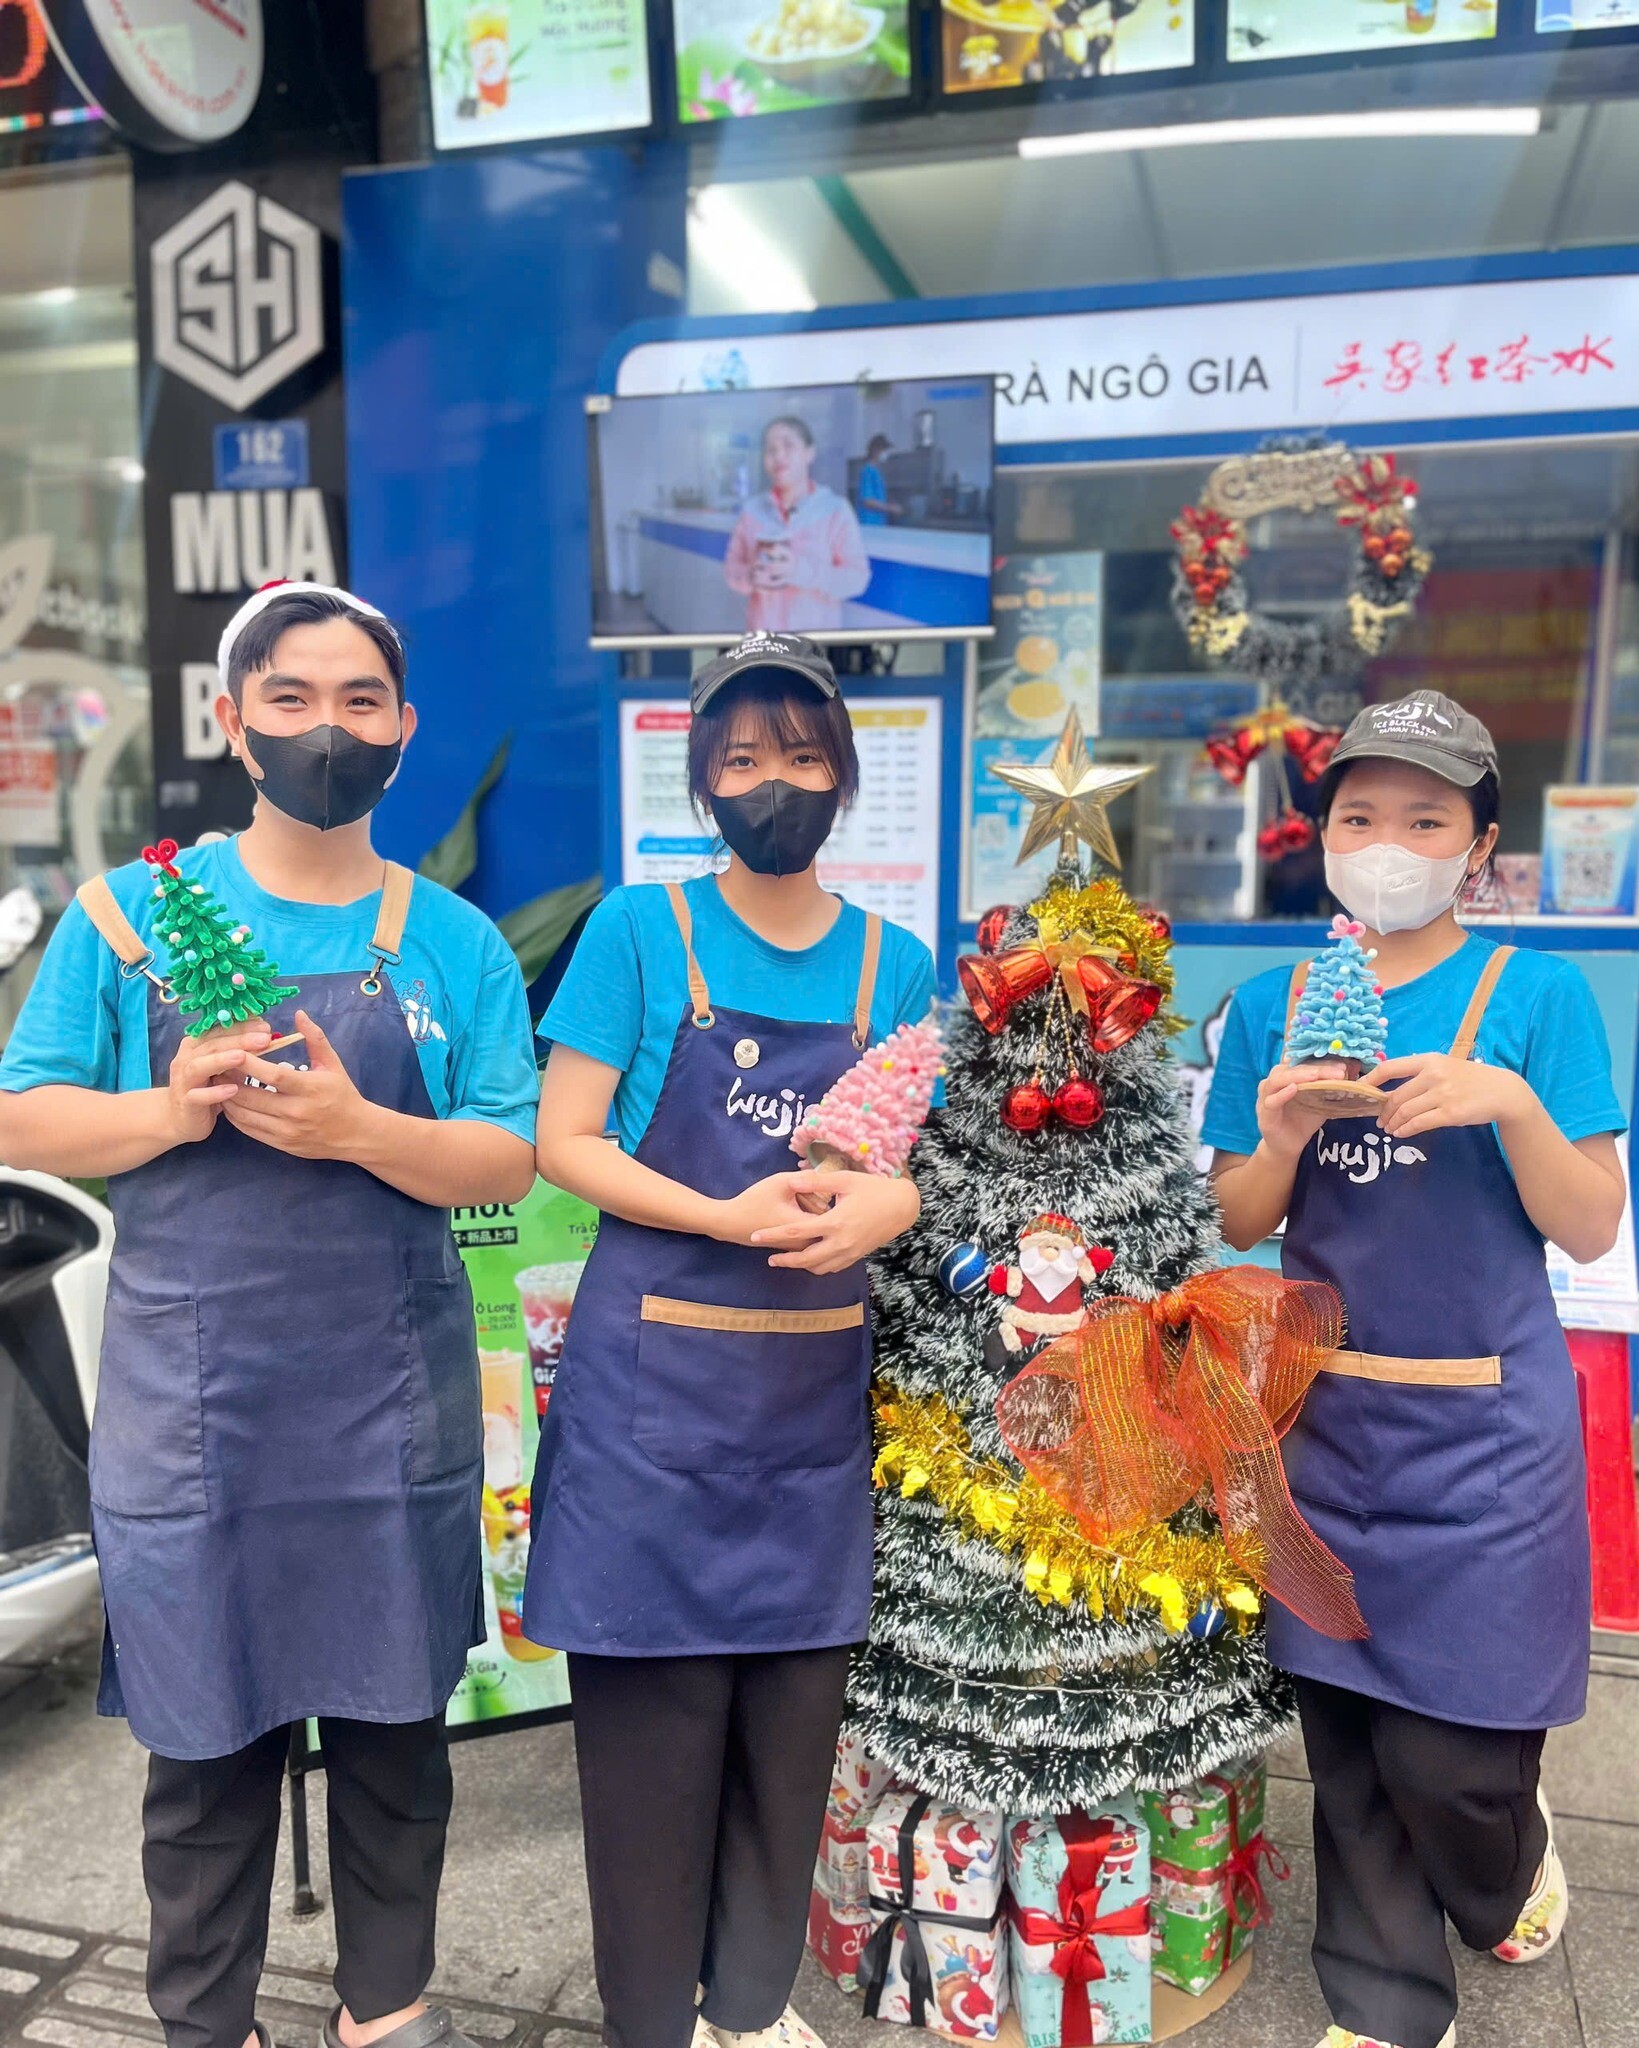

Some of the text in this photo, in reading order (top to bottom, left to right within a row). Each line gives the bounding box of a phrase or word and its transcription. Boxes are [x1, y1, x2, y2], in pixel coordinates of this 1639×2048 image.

[994, 353, 1269, 405] RÀ NGÔ GIA
[170, 487, 337, 593] MUA
[1373, 720, 1437, 736] ICE BLACK TEA
[1379, 727, 1409, 735] TAIWAN
[487, 1302, 517, 1313] Long
